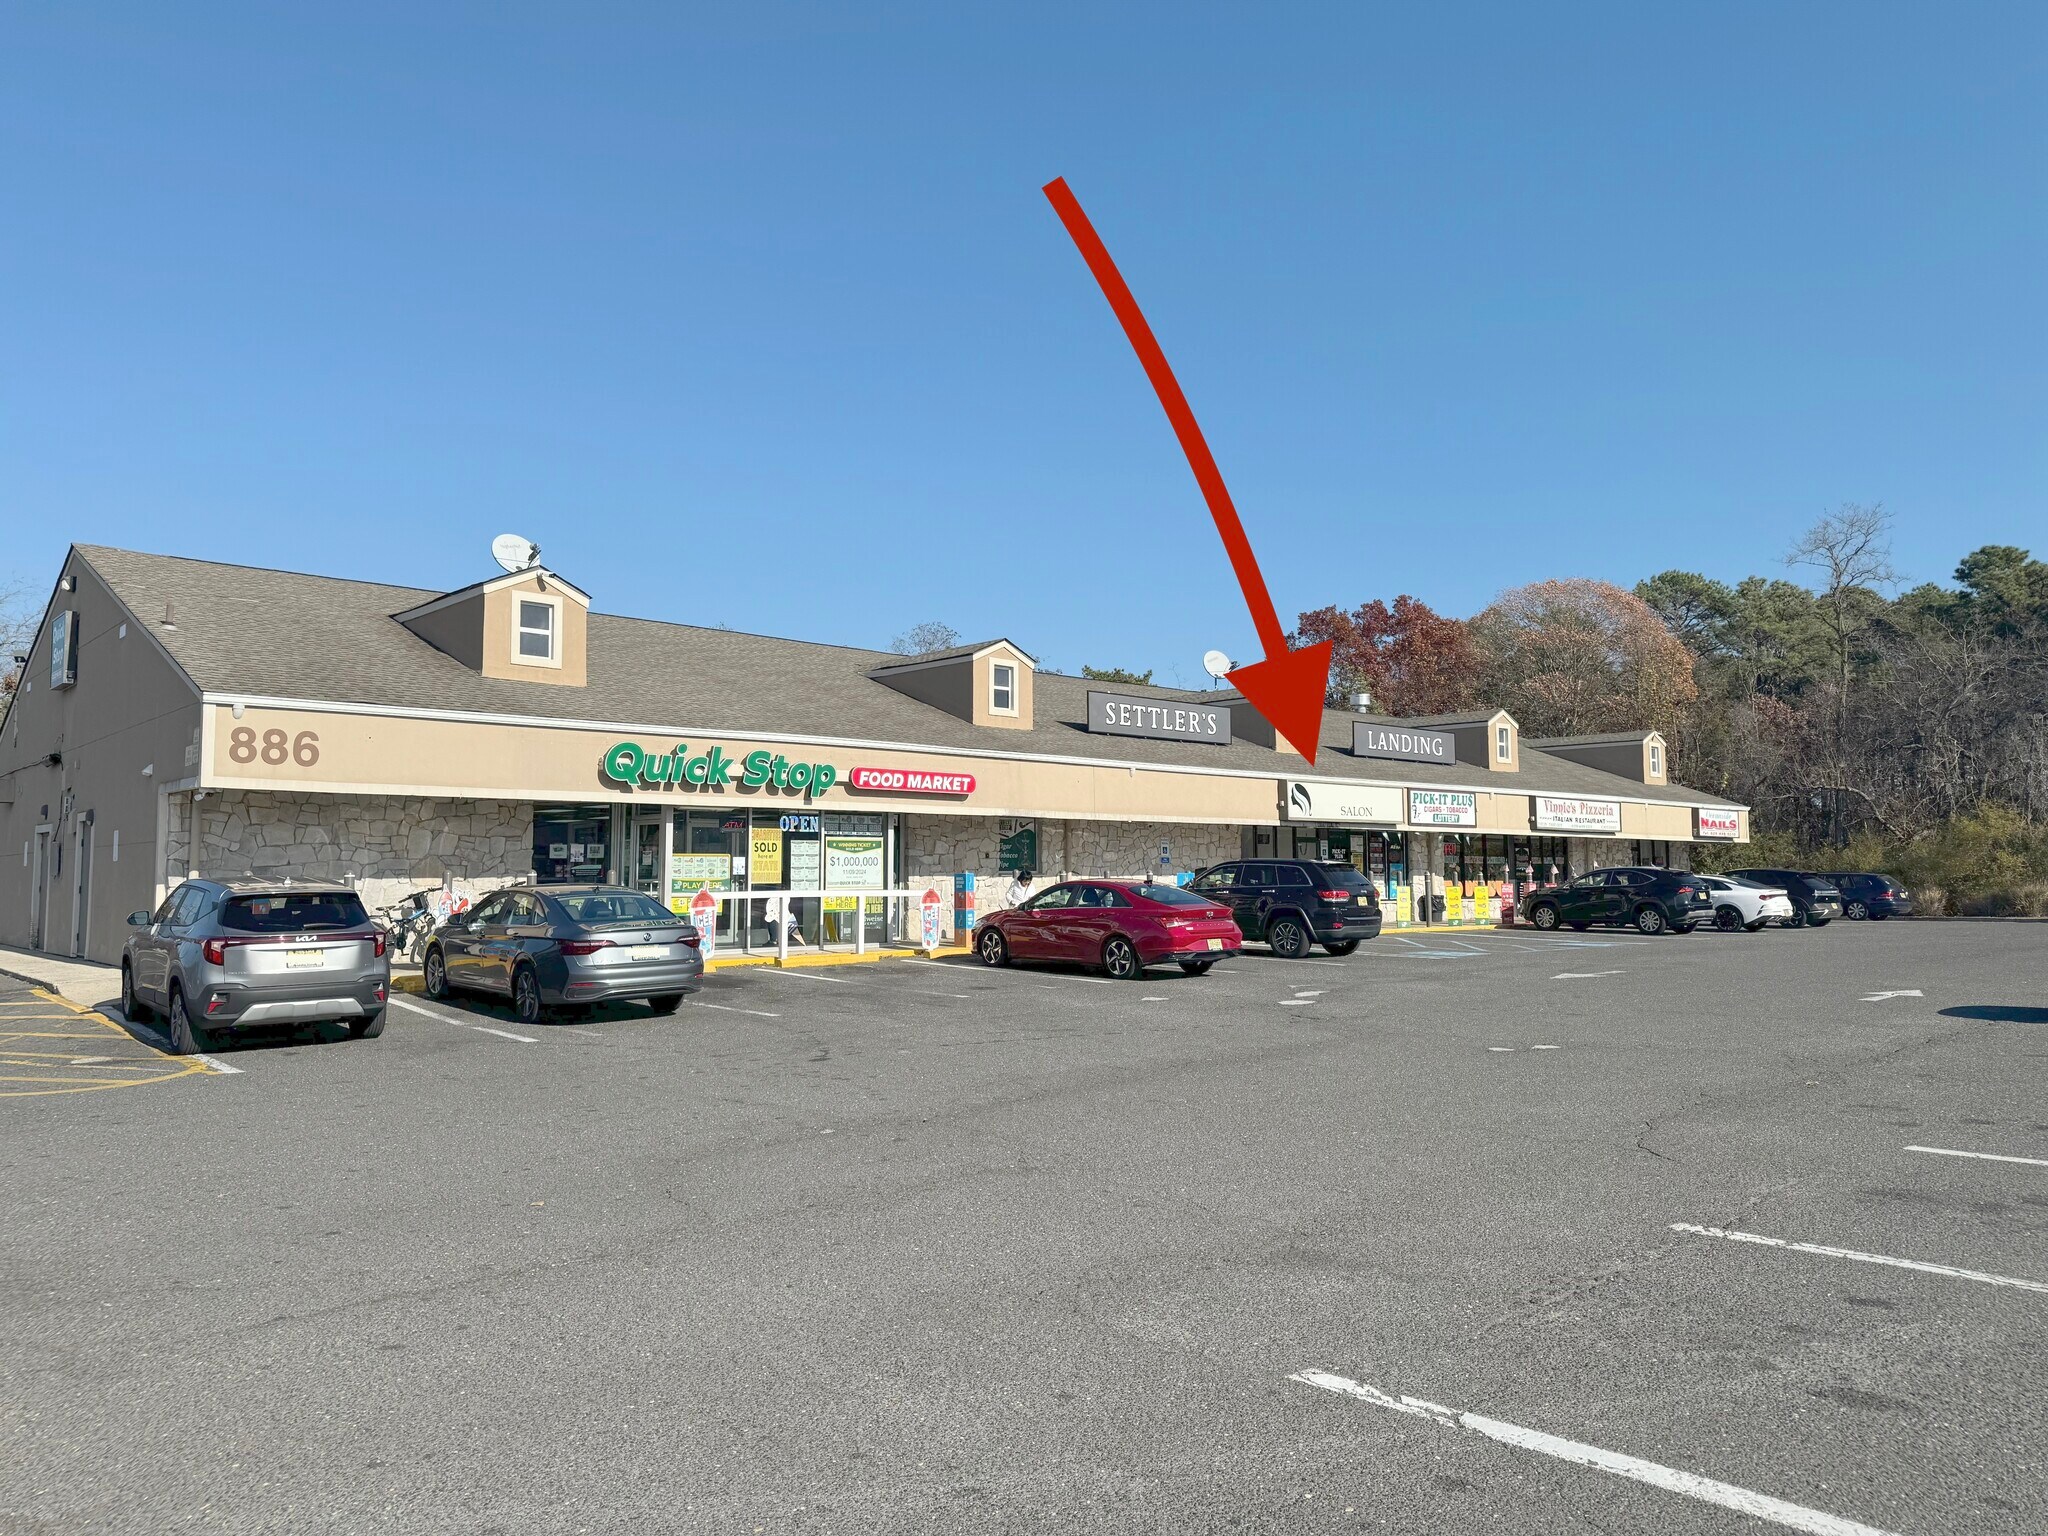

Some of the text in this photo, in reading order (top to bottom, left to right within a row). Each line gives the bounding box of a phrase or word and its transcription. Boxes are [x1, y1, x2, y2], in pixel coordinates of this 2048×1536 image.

[1105, 702, 1217, 735] SETTLER'S
[229, 726, 320, 767] 886
[1367, 730, 1443, 756] LANDING
[604, 742, 837, 798] Quick Stop
[858, 770, 972, 792] FOOD MARKET
[1340, 805, 1373, 817] SALON
[1423, 805, 1468, 814] CIGARS TOBACCO
[1544, 799, 1614, 817] Vinnie's Pizzeria
[780, 815, 819, 833] OPEN
[1434, 813, 1459, 823] LOTTERY
[1552, 815, 1573, 823] ITALIAN
[1700, 817, 1737, 830] NAILS
[722, 821, 743, 829] ATM
[754, 842, 778, 853] SOLD
[753, 860, 779, 872] STATE
[829, 856, 879, 867] $1,000,000
[682, 881, 702, 889] PLAY
